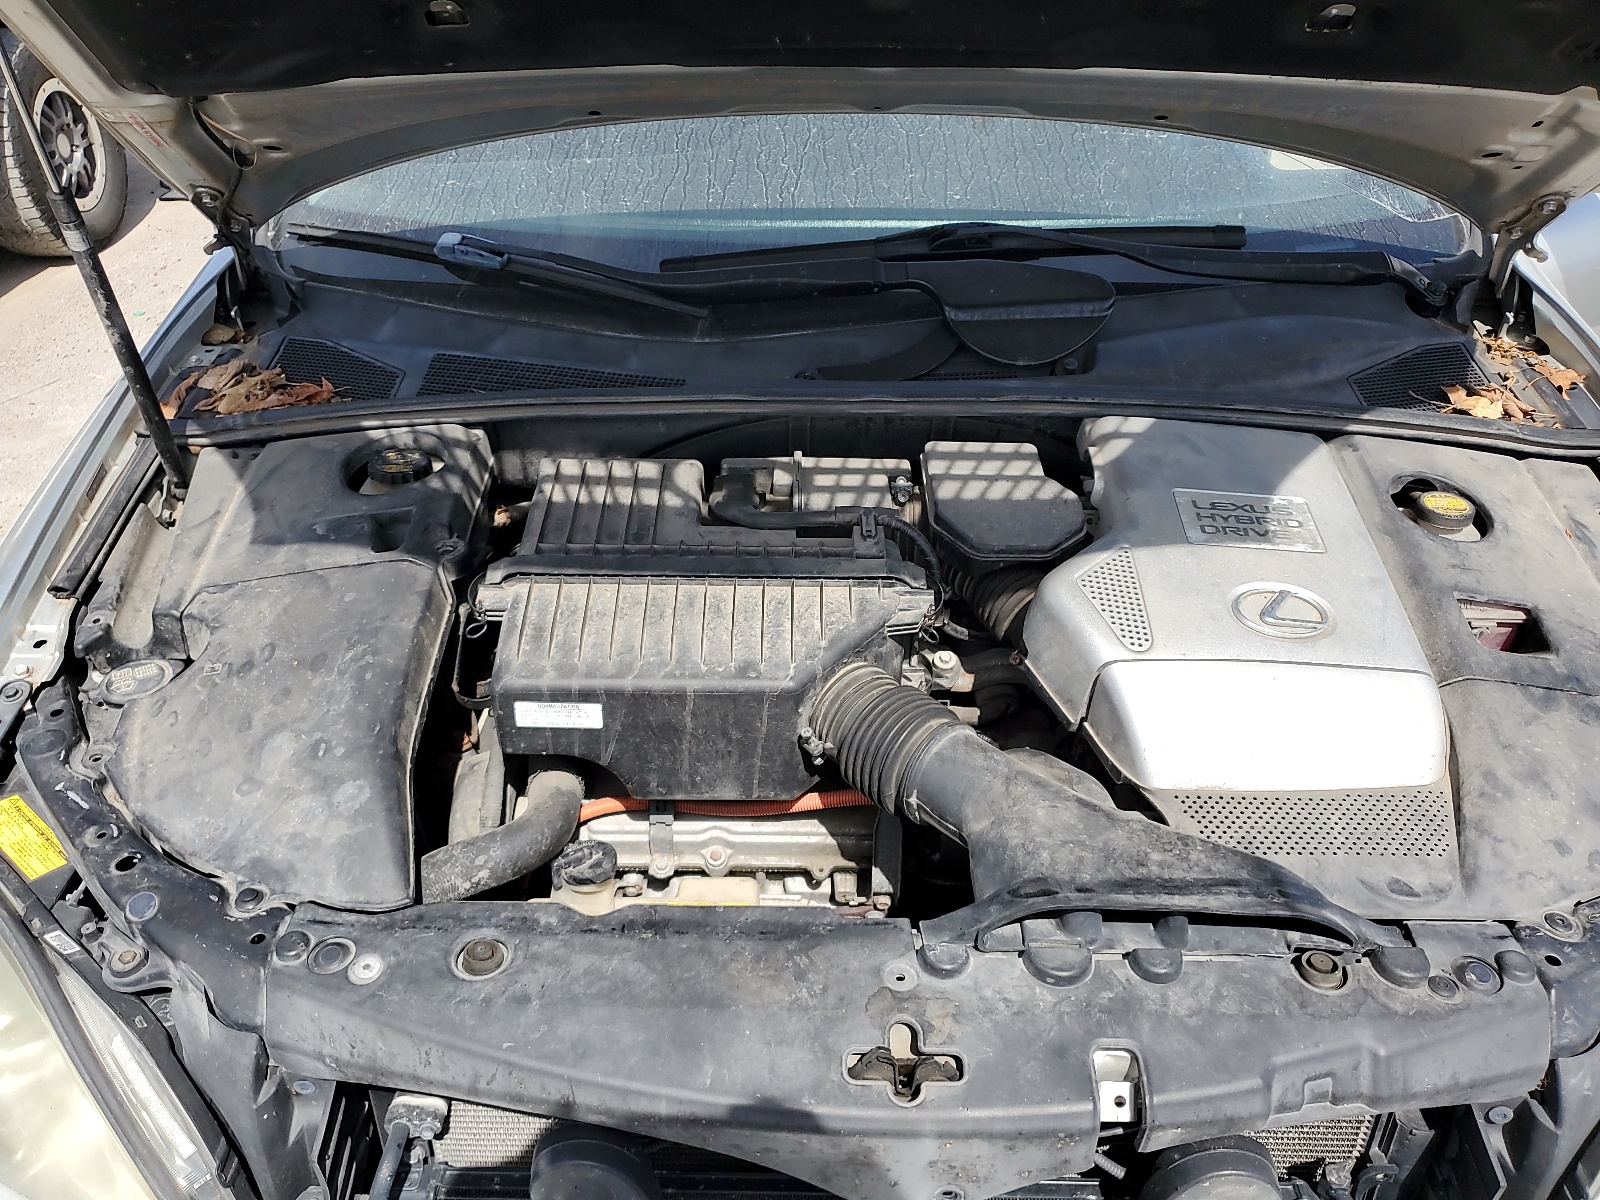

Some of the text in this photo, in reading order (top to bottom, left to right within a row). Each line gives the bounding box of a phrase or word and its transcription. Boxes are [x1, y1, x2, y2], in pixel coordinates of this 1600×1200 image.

[1191, 500, 1294, 516] LEXUS
[1195, 512, 1303, 529] HYBRID
[1199, 524, 1292, 540] DRIVE
